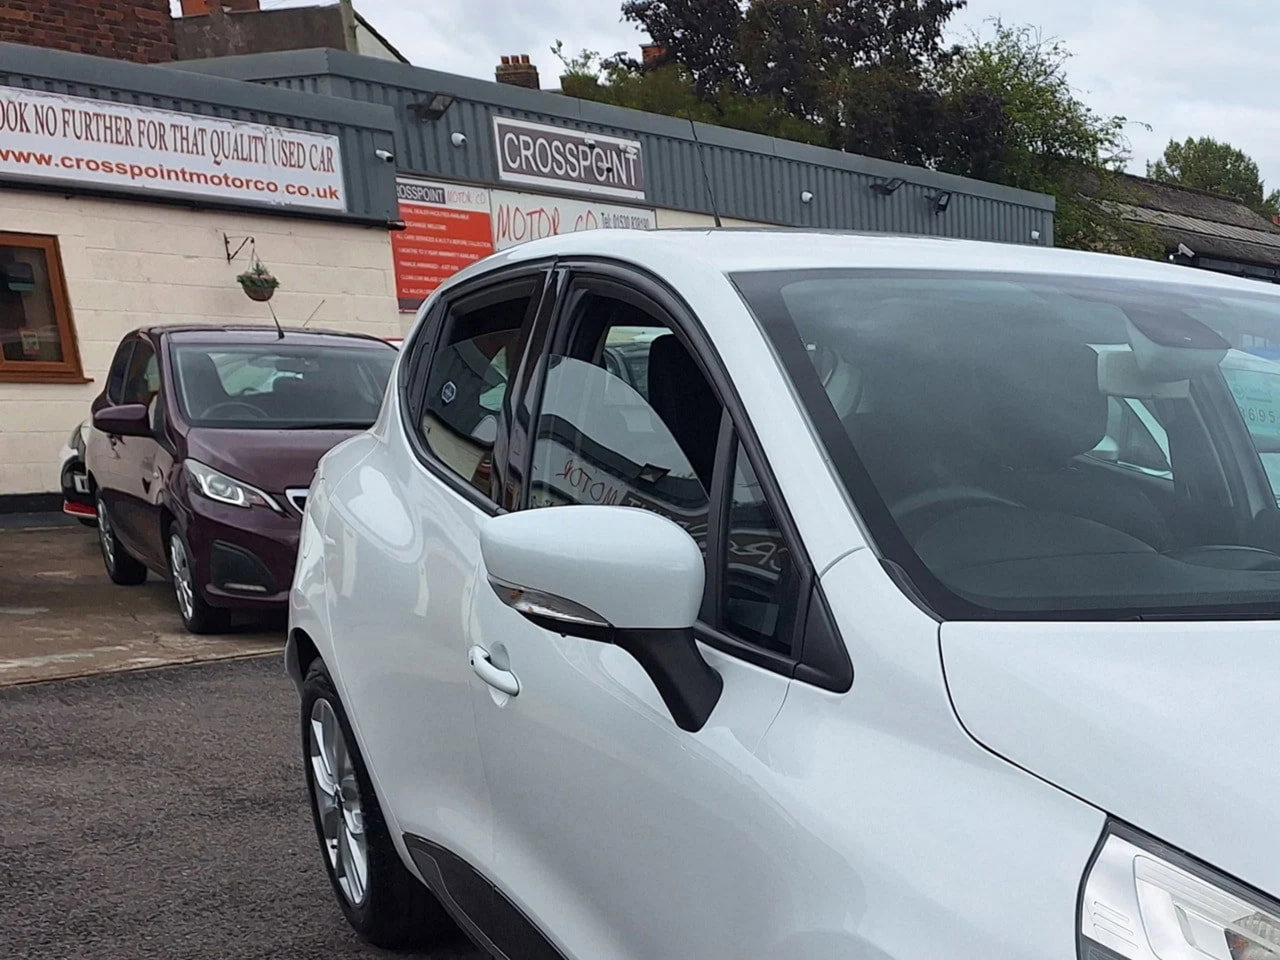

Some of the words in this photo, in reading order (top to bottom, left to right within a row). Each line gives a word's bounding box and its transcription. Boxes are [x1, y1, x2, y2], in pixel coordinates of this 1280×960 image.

[33, 103, 57, 137] NO
[62, 107, 134, 147] FURTHER
[137, 117, 168, 151] FOR
[171, 124, 207, 156] THAT
[210, 129, 267, 166] QUALITY
[271, 137, 306, 169] USED
[309, 143, 335, 173] CAR
[503, 132, 638, 186] CROSSPOINT
[496, 203, 560, 242] MOTOR
